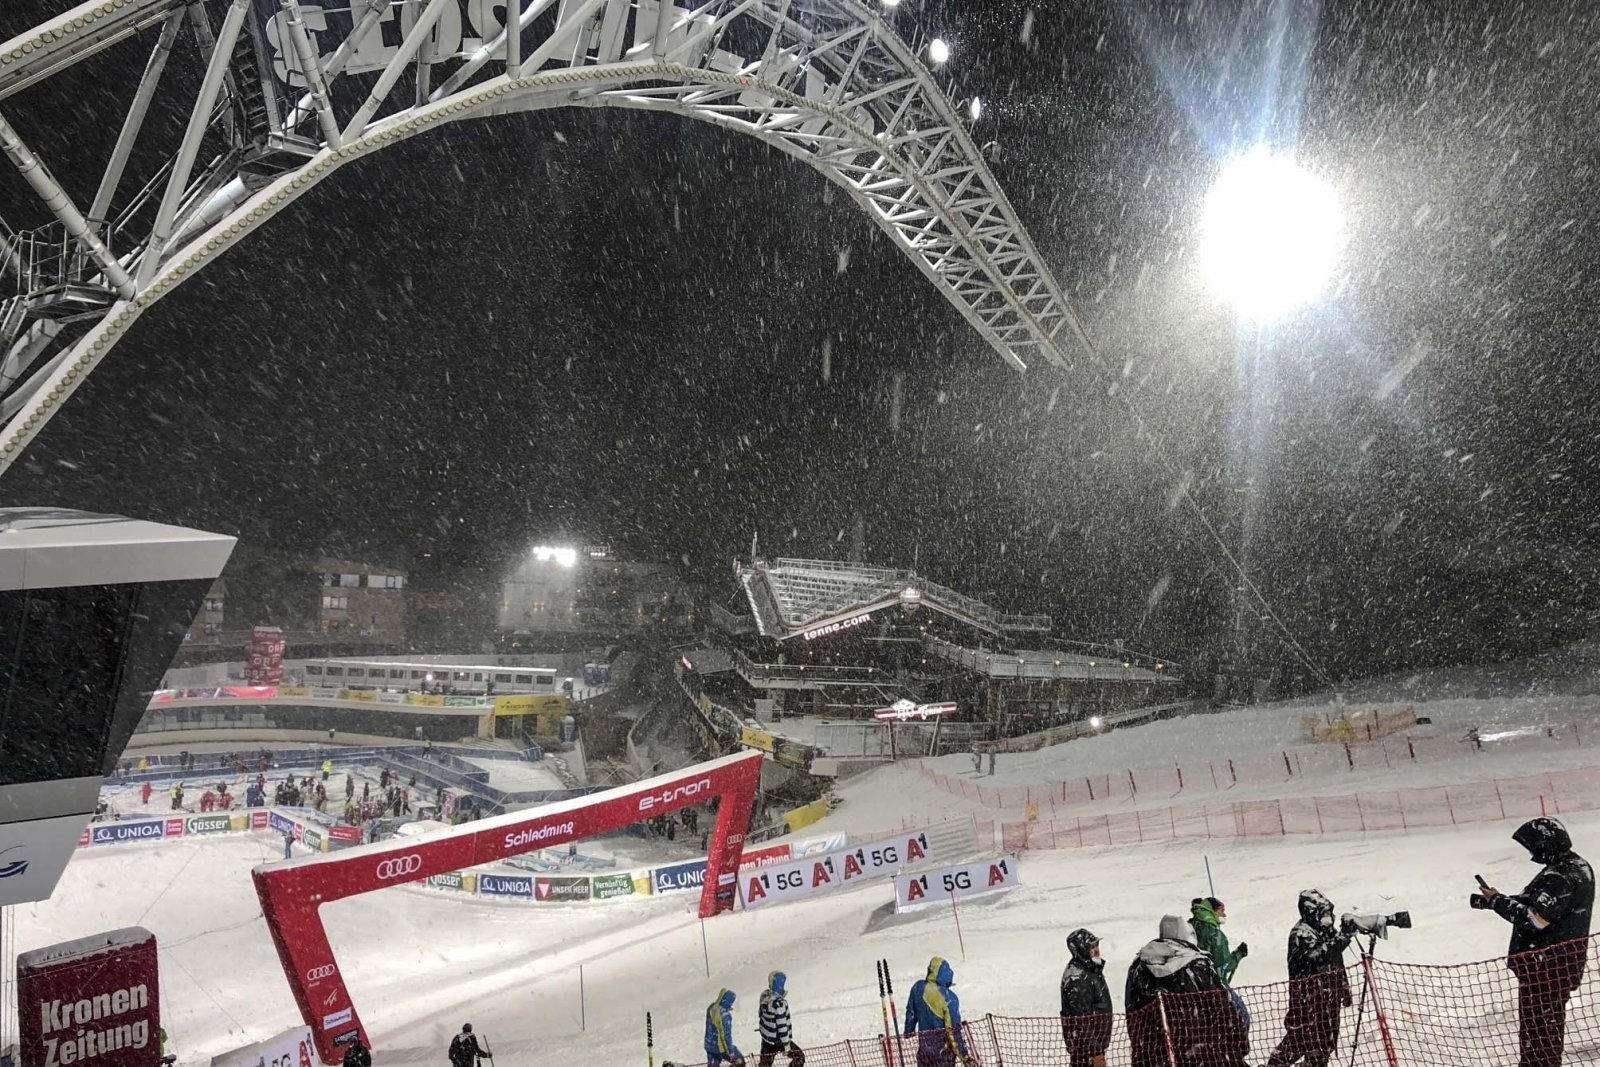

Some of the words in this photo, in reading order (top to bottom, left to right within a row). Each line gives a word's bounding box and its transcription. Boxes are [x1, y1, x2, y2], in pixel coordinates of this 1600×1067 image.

[803, 613, 870, 640] tenne.com
[638, 778, 710, 811] e-tron
[117, 825, 161, 838] UNIQA
[503, 821, 574, 848] Schladming
[844, 849, 865, 881] A1
[872, 847, 898, 867] 5G
[907, 833, 928, 863] A1
[498, 880, 531, 893] UNIQA
[552, 885, 572, 894] UNSER
[573, 886, 588, 894] HEER
[748, 872, 770, 903] A1
[776, 870, 803, 890] 5G
[812, 856, 834, 887] A1
[907, 875, 928, 901] A1
[943, 871, 971, 892] 5G
[988, 859, 1008, 886] A1
[41, 984, 148, 1034] Kronen
[43, 1019, 149, 1067] Zeitung
